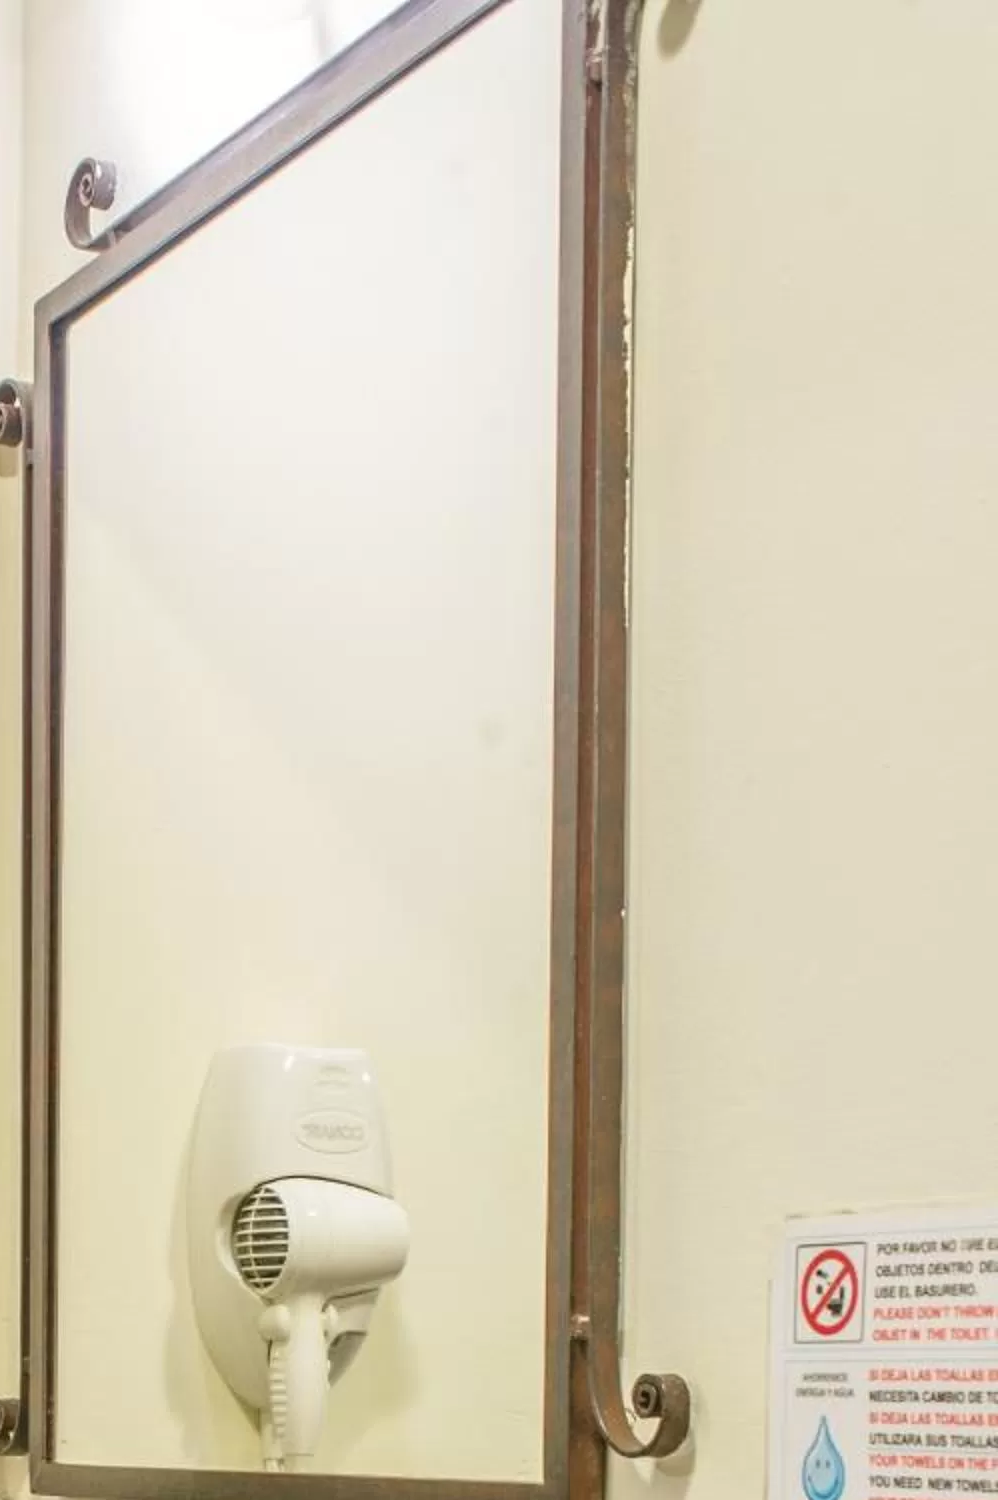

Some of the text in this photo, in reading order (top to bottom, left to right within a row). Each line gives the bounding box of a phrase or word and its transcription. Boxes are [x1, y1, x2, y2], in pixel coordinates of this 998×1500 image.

[877, 1242, 900, 1254] POR
[903, 1241, 937, 1254] FAVOR
[941, 1240, 957, 1252] NO
[875, 1263, 924, 1277] OBJETOS
[928, 1261, 973, 1274] DENTRO
[874, 1285, 896, 1298] USE
[899, 1285, 912, 1298] EL
[873, 1307, 913, 1320] PLEASE
[953, 1305, 994, 1318] THROW
[927, 1327, 947, 1340] THE
[869, 1369, 879, 1381] SI
[882, 1369, 907, 1381] DEJA
[910, 1369, 931, 1381] LAS
[935, 1368, 984, 1382] TOALLAS
[869, 1390, 920, 1403] NECESITA
[922, 1390, 965, 1404] CAMBIO
[968, 1391, 983, 1404] DE
[882, 1411, 907, 1425] DEJA
[910, 1411, 931, 1425] LAS
[935, 1412, 984, 1426] TOALLAS
[925, 1433, 947, 1447] SUS
[868, 1454, 898, 1468] YOUR
[900, 1455, 945, 1469] TOWELS
[948, 1457, 965, 1469] ON
[968, 1457, 987, 1471] THE
[868, 1475, 891, 1489] YOU
[893, 1476, 923, 1489] NEED
[927, 1477, 953, 1491] NEW
